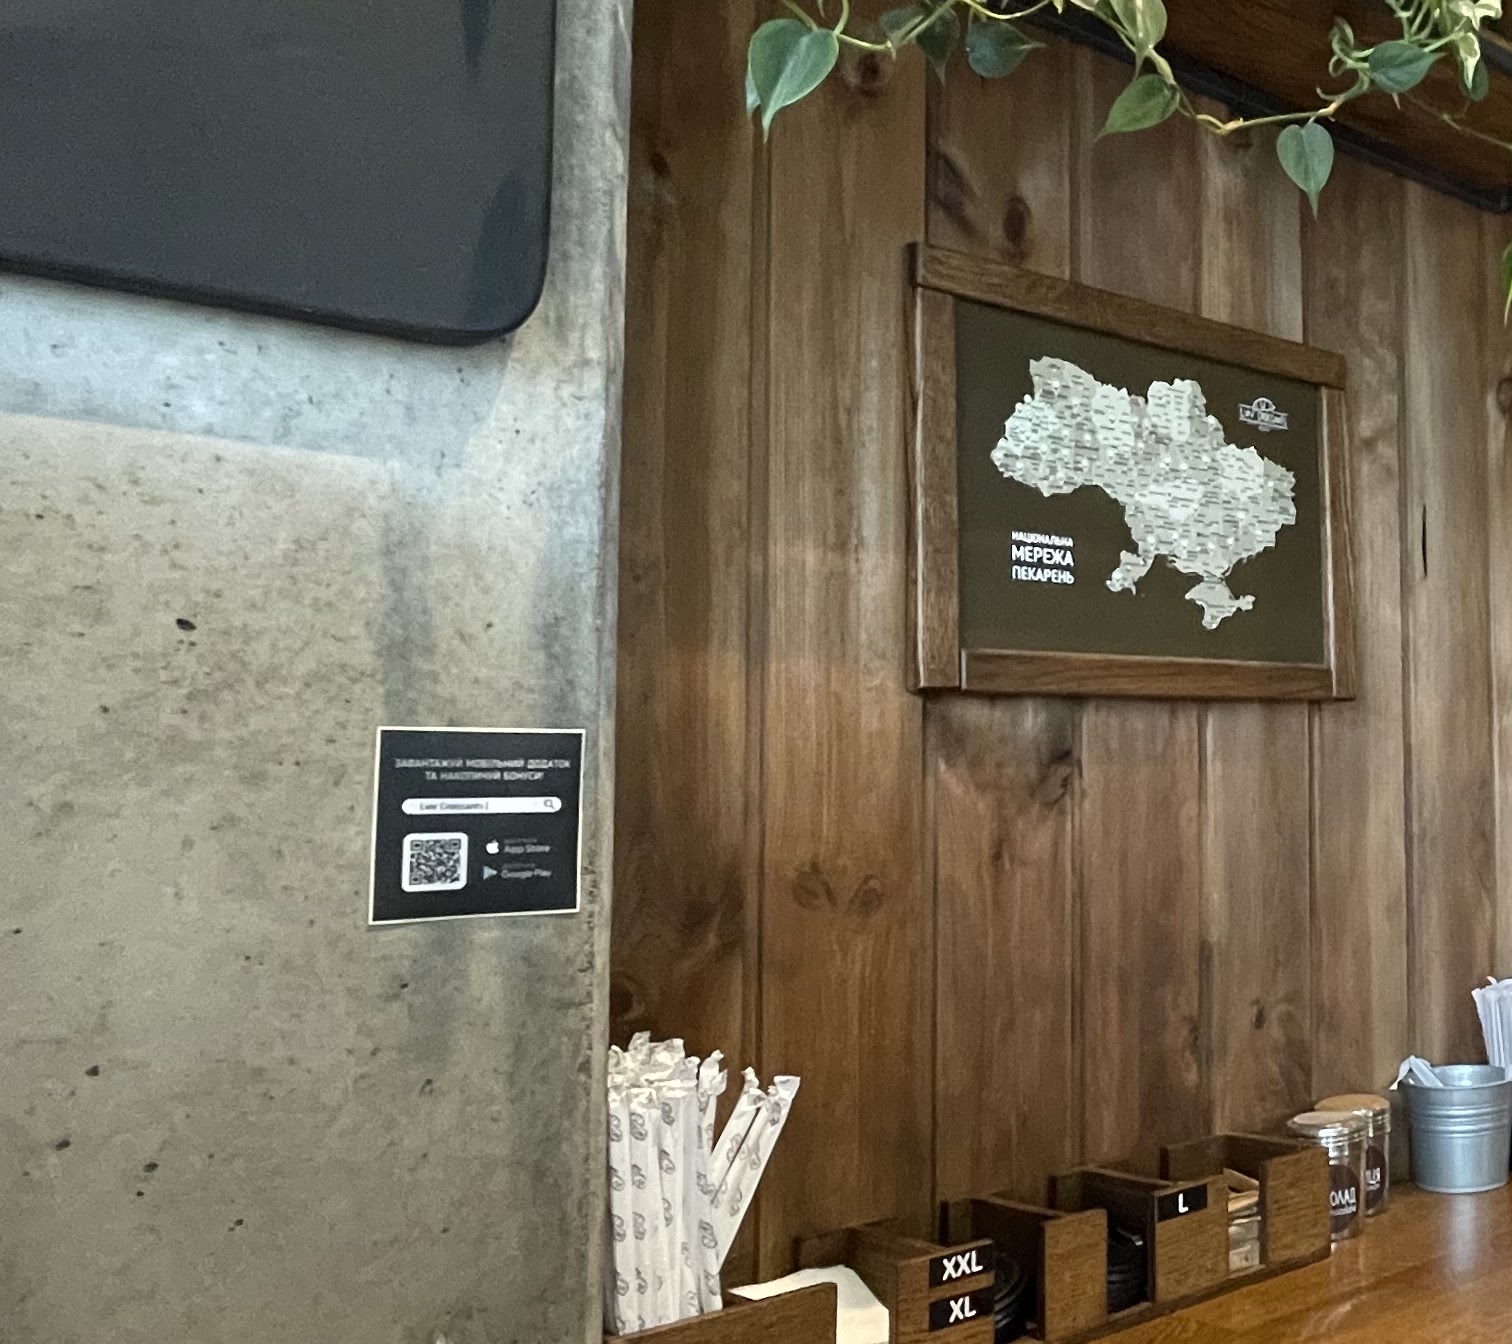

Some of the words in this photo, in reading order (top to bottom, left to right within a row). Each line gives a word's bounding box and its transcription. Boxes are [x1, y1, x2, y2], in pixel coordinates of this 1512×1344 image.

[1012, 544, 1075, 567] МЕРЕЖА
[1012, 565, 1075, 584] ПЕКАРЕНЬ
[1178, 1193, 1189, 1214] L
[943, 1250, 984, 1281] XXL
[948, 1295, 977, 1323] XL
